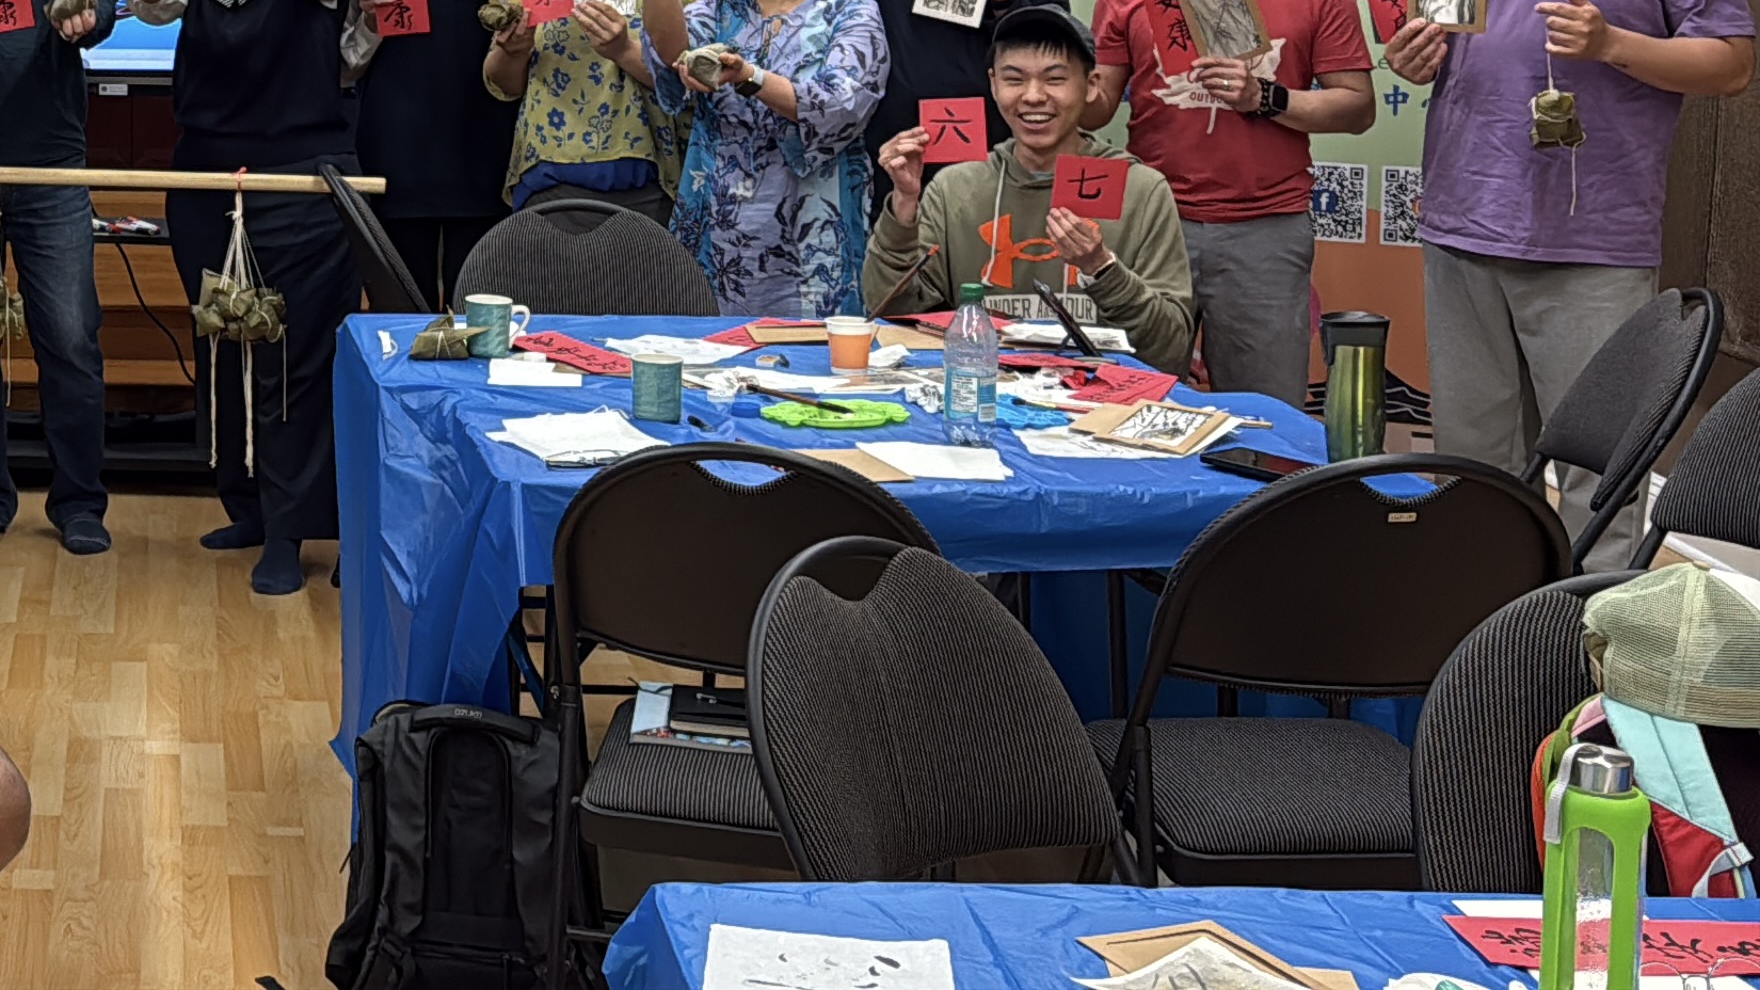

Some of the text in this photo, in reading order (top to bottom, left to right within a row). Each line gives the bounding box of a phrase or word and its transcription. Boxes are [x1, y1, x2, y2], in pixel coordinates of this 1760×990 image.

[1383, 84, 1409, 117] 中
[929, 107, 972, 145] 六
[1067, 168, 1109, 200] 七
[984, 297, 1094, 321] NDER AOUR
